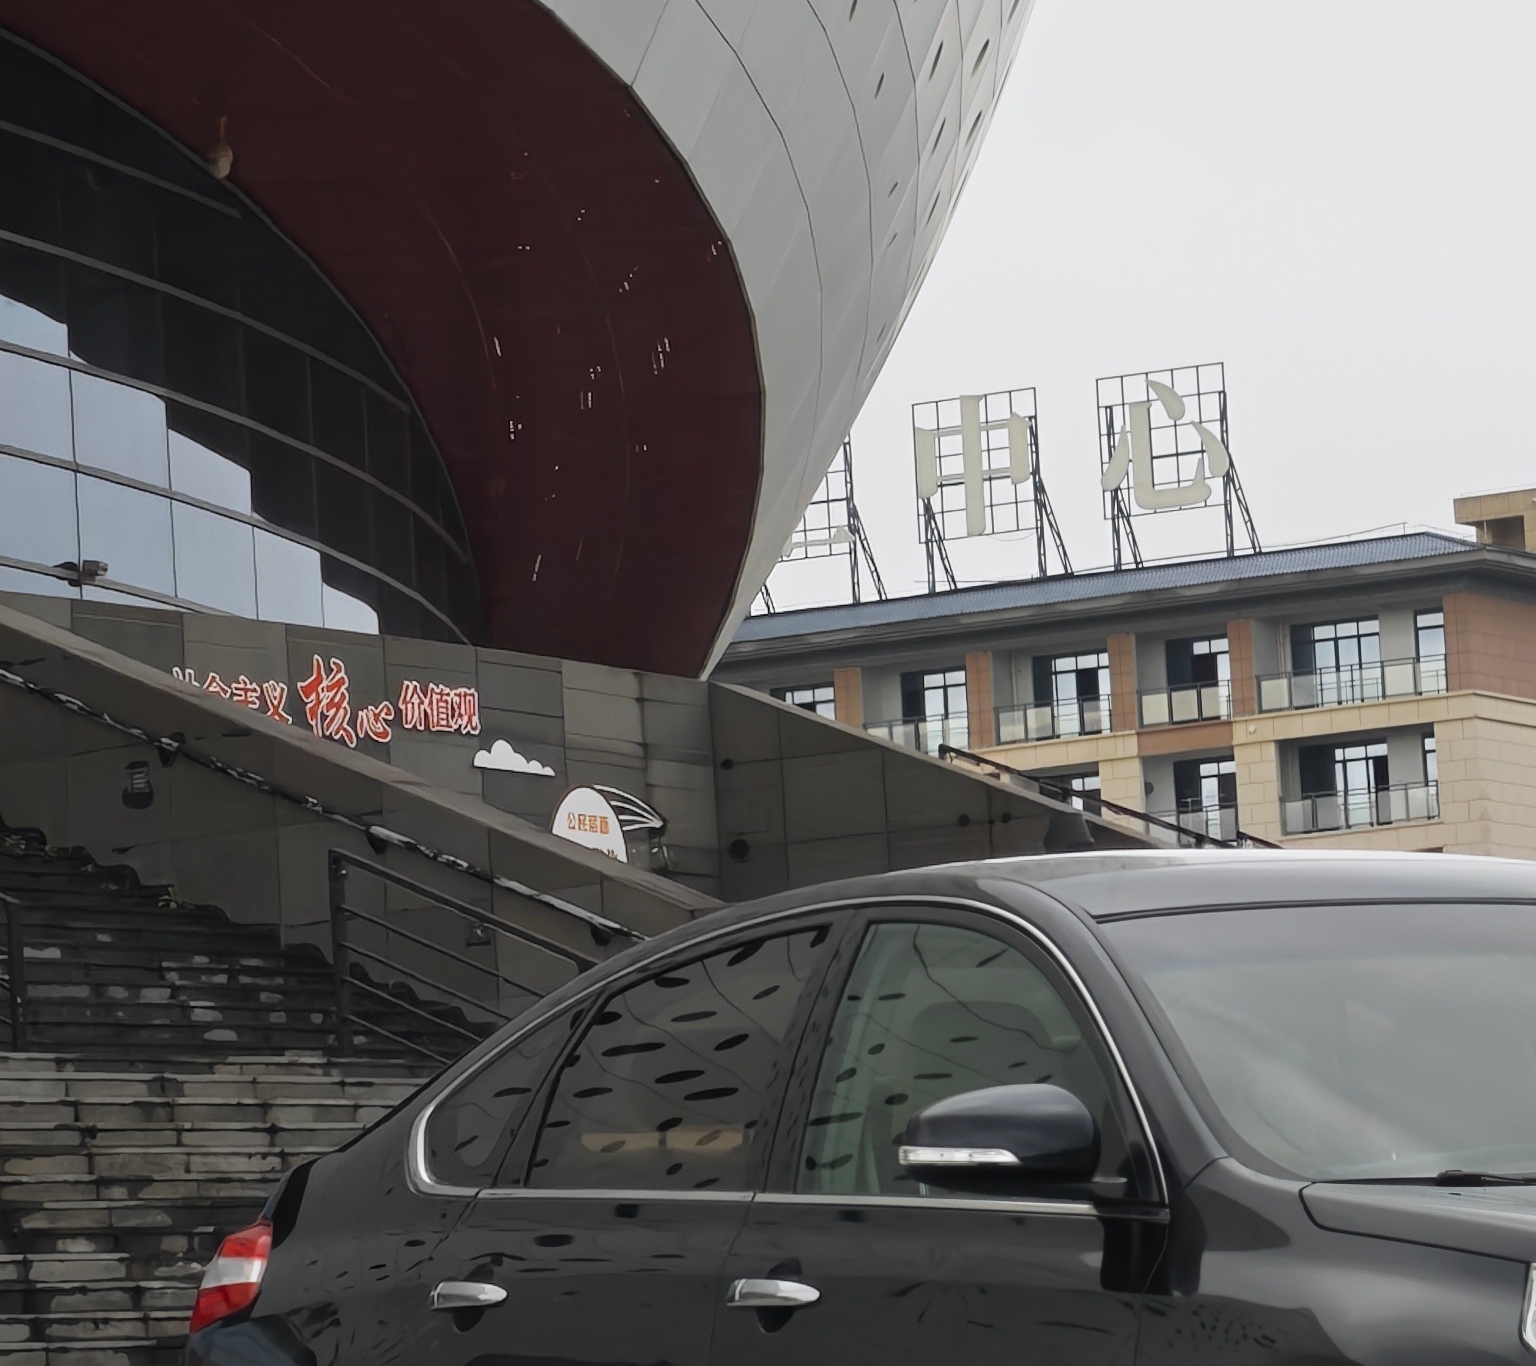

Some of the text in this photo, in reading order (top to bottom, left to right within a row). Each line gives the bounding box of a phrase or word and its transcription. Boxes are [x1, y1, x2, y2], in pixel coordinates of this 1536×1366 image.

[783, 378, 1230, 557] 中心
[172, 654, 481, 748] 主义核心价值观
